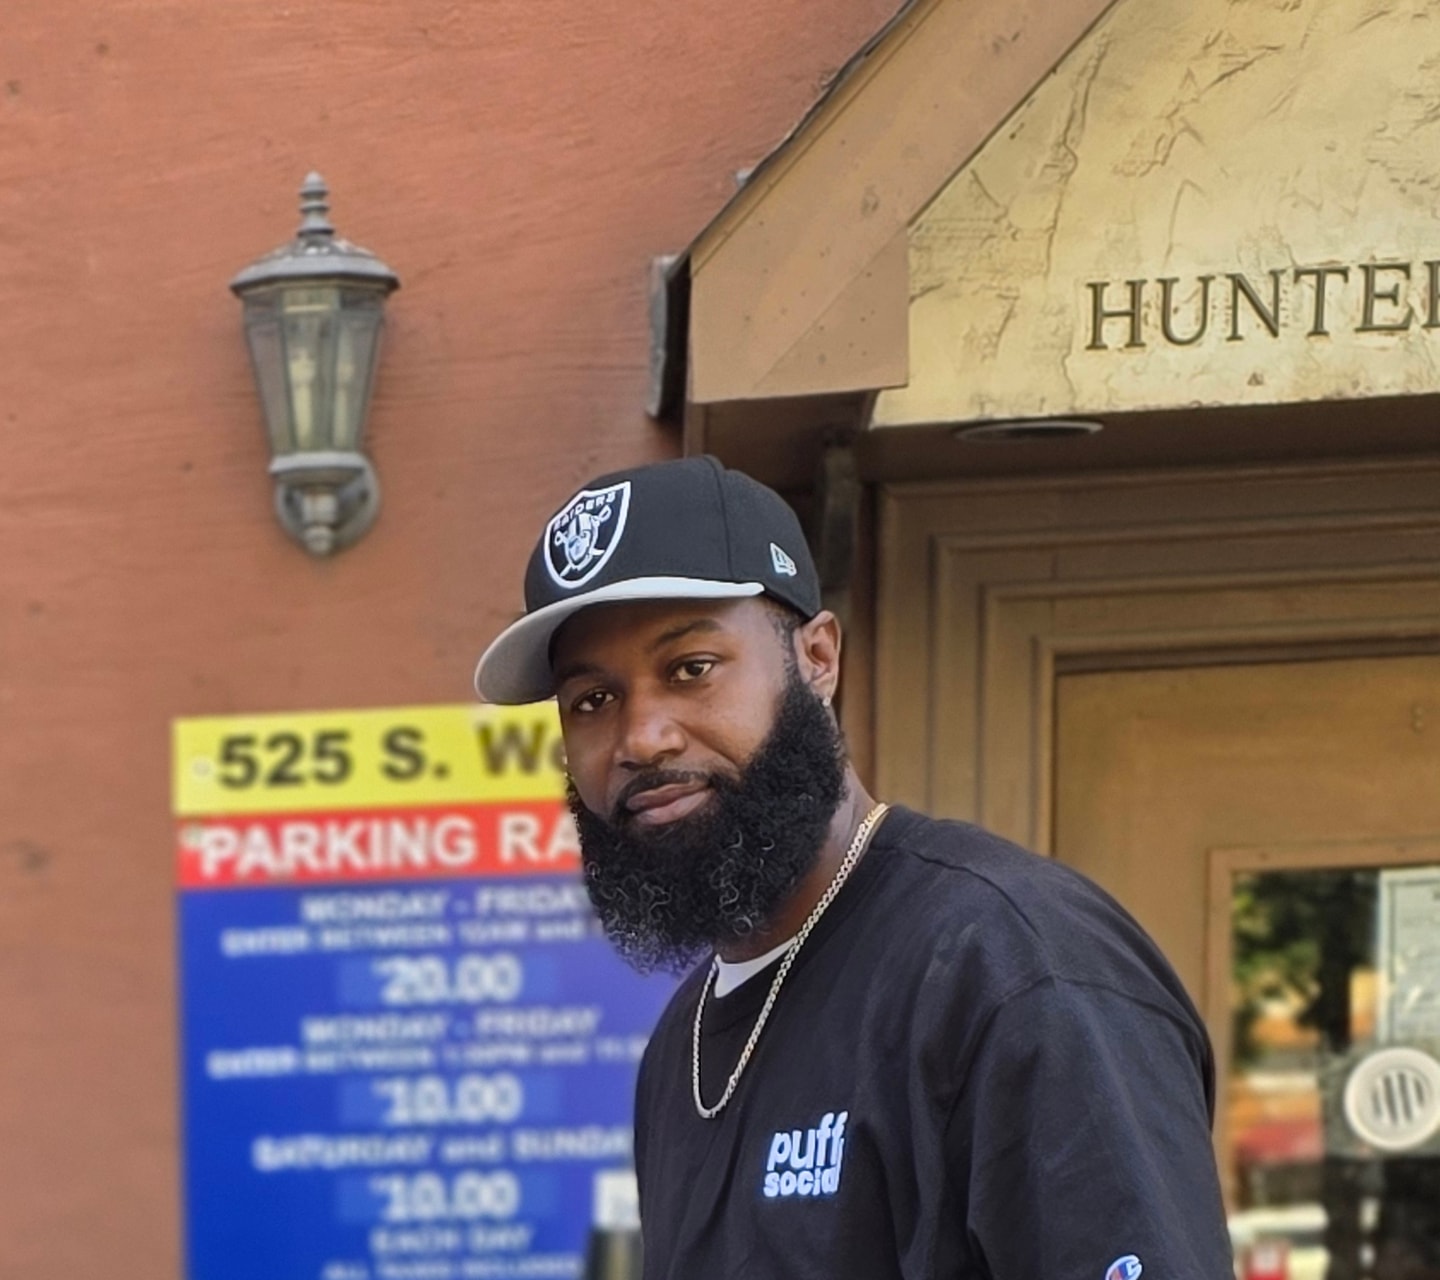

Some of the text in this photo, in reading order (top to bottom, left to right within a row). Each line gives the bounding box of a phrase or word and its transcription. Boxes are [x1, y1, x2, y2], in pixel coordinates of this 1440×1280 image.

[219, 730, 351, 788] 525
[381, 726, 449, 781] S.
[199, 812, 583, 879] PARKING RA
[301, 893, 449, 922] MONDAY
[476, 887, 588, 915] FRIDA
[301, 1013, 449, 1043] MONDAY
[512, 1127, 635, 1161] SUNDA
[763, 1137, 845, 1198] social
[766, 1110, 849, 1171] puff
